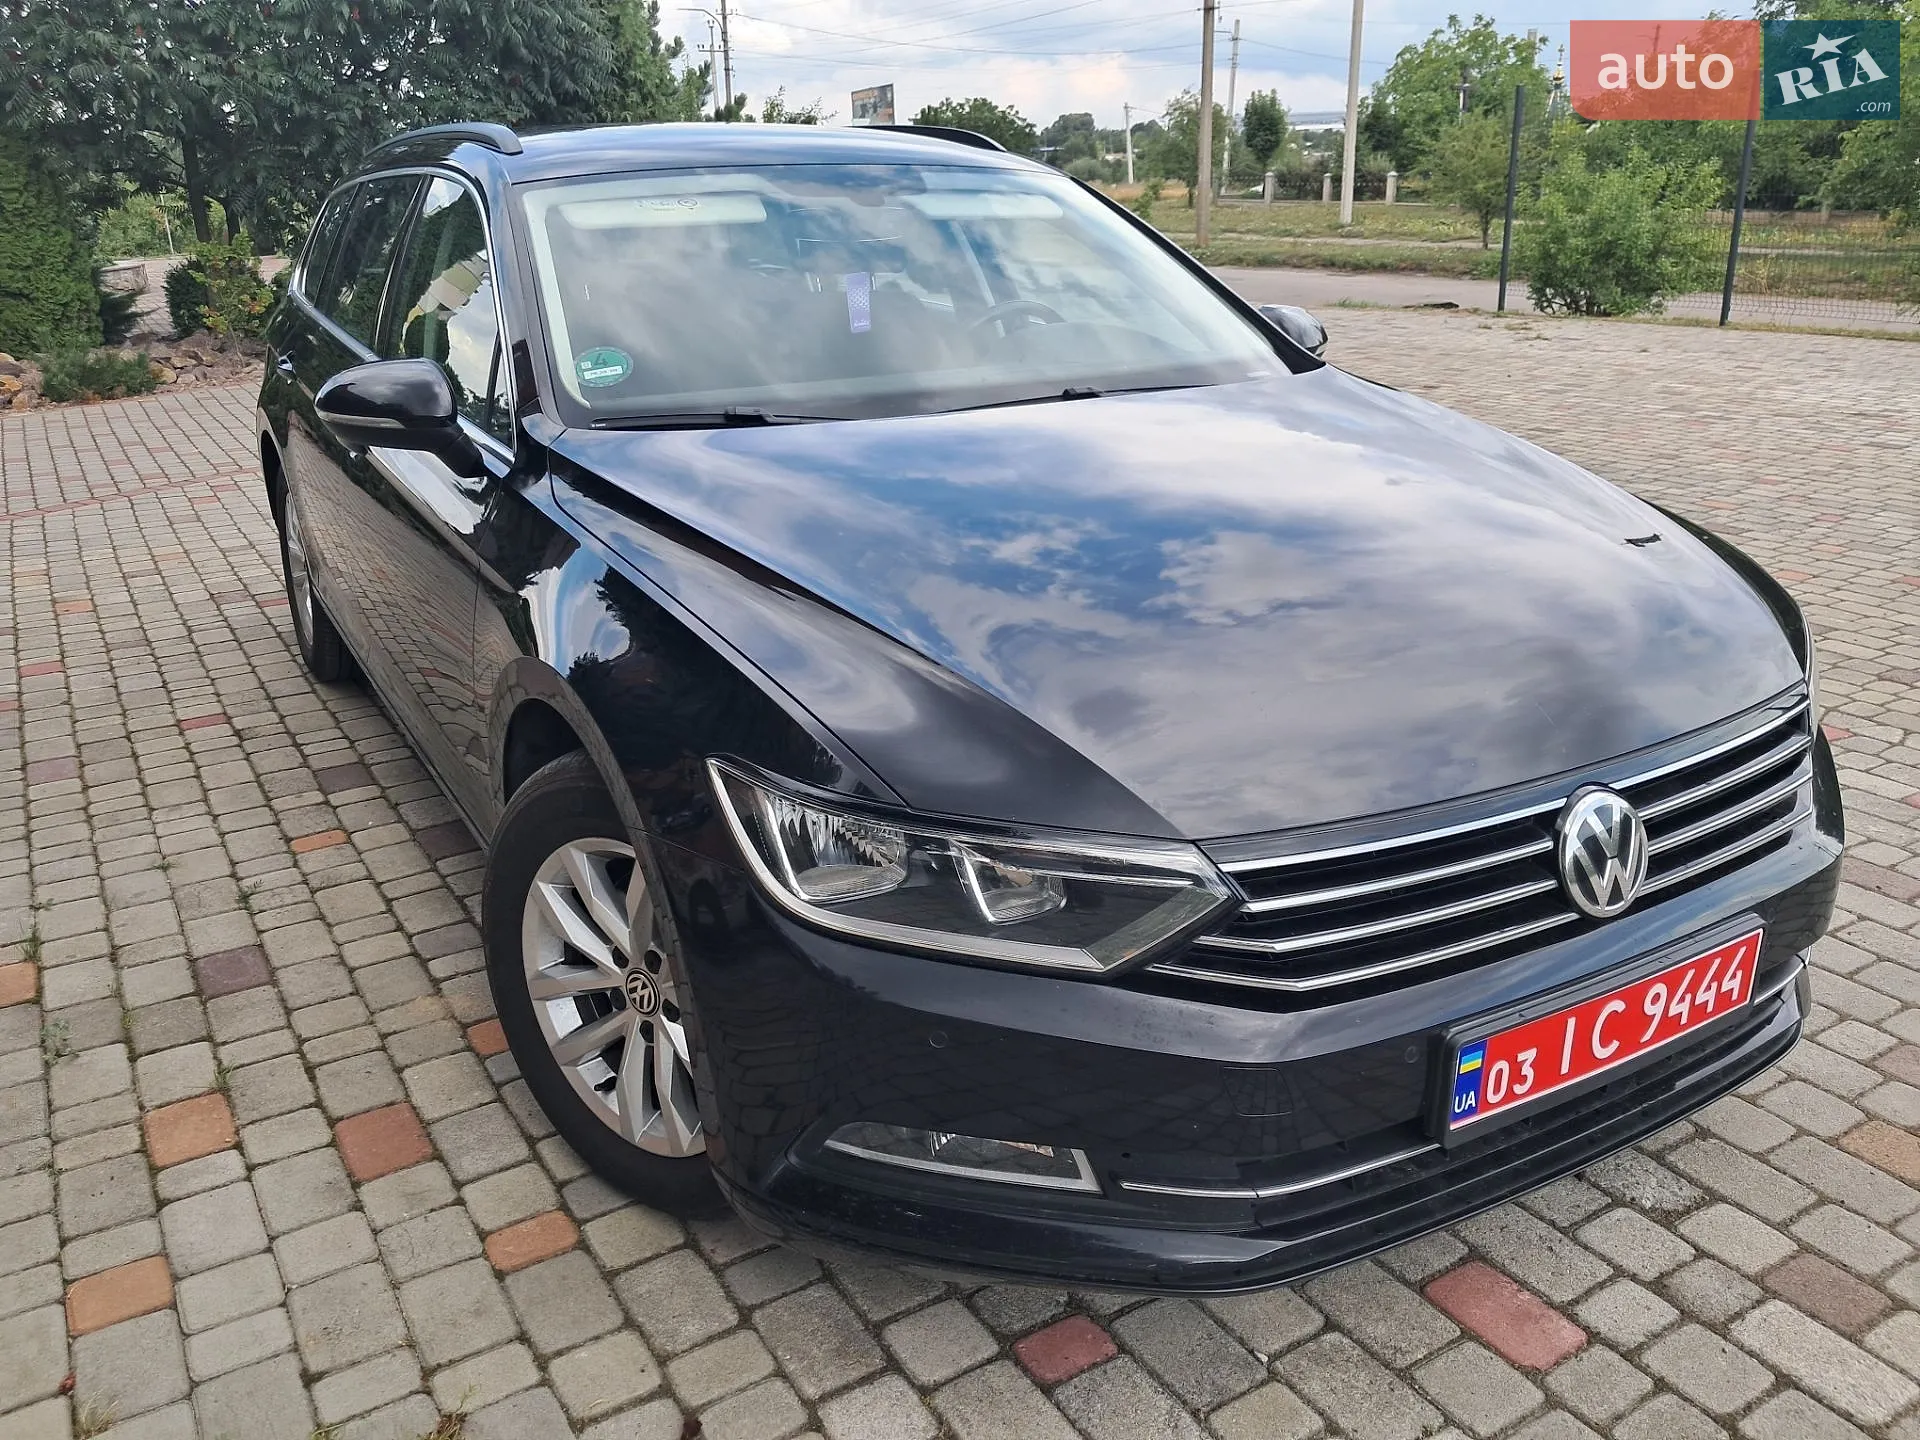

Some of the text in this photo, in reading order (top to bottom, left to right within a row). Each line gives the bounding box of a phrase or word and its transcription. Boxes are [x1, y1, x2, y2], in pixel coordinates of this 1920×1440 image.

[1485, 945, 1748, 1105] 03 IC 9444
[1453, 1089, 1477, 1114] UA
